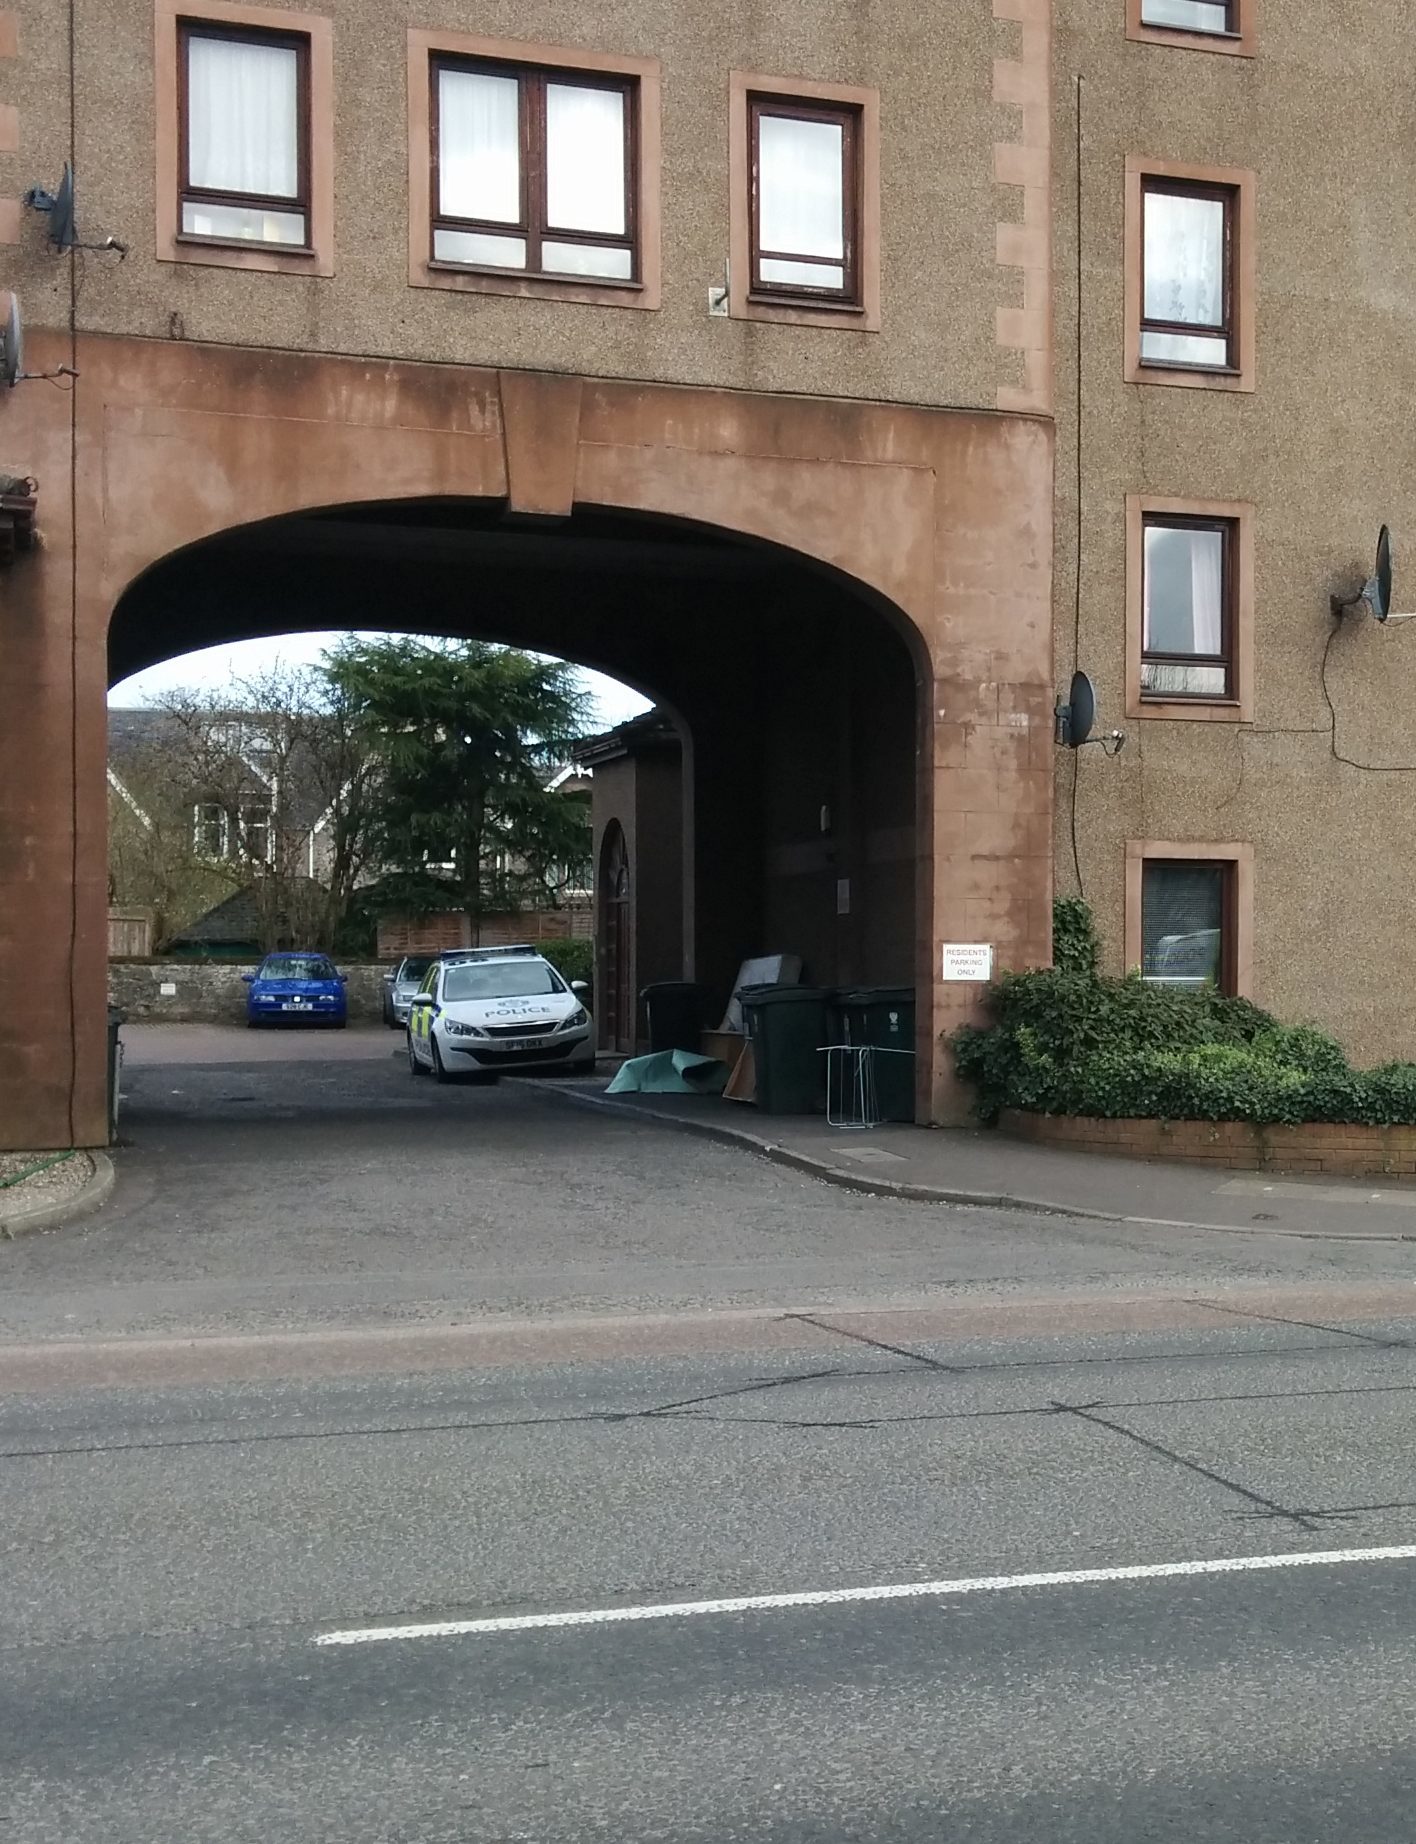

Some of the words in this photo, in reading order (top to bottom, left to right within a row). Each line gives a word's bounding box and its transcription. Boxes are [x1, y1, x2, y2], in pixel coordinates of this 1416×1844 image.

[950, 959, 983, 967] PARKING
[957, 969, 976, 977] ONLY
[484, 1006, 552, 1018] POLICE
